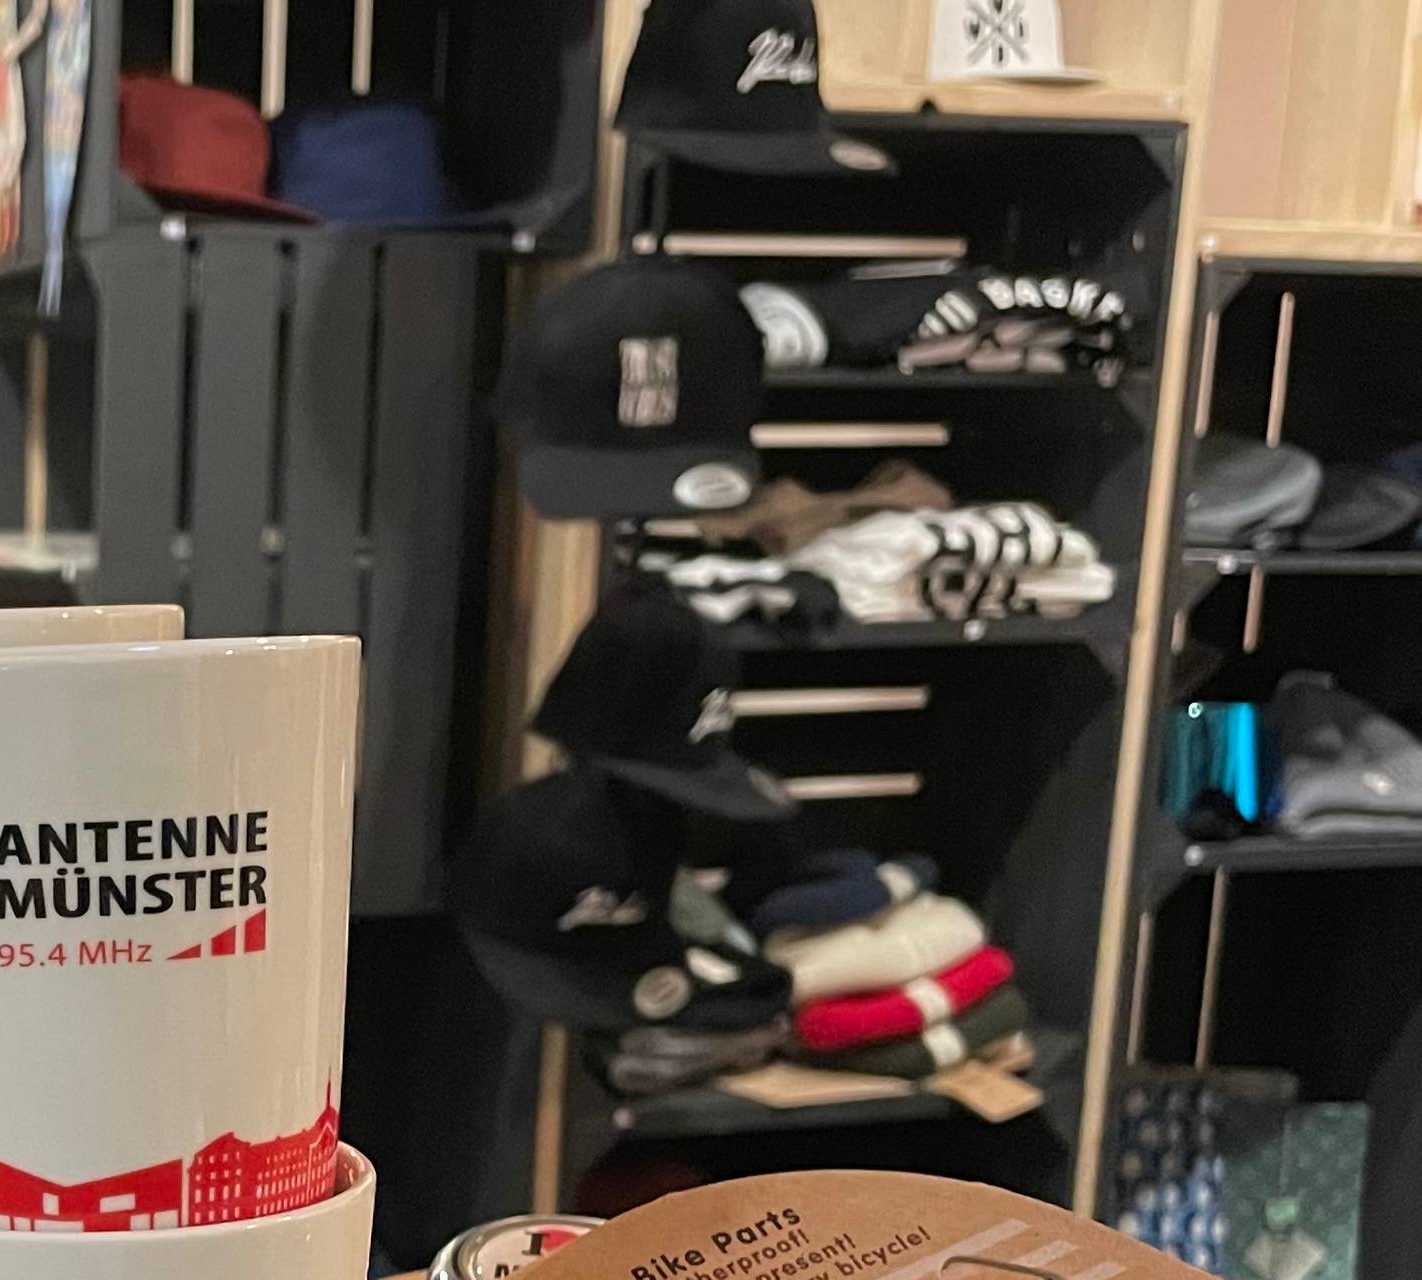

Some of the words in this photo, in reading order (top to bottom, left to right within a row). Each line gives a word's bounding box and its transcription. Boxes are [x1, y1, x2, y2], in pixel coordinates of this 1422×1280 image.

[79, 939, 152, 965] MHz
[631, 1250, 706, 1280] Bike
[711, 1207, 801, 1254] Parts
[686, 1229, 810, 1280] herproof!
[834, 1226, 931, 1277] bicycle!
